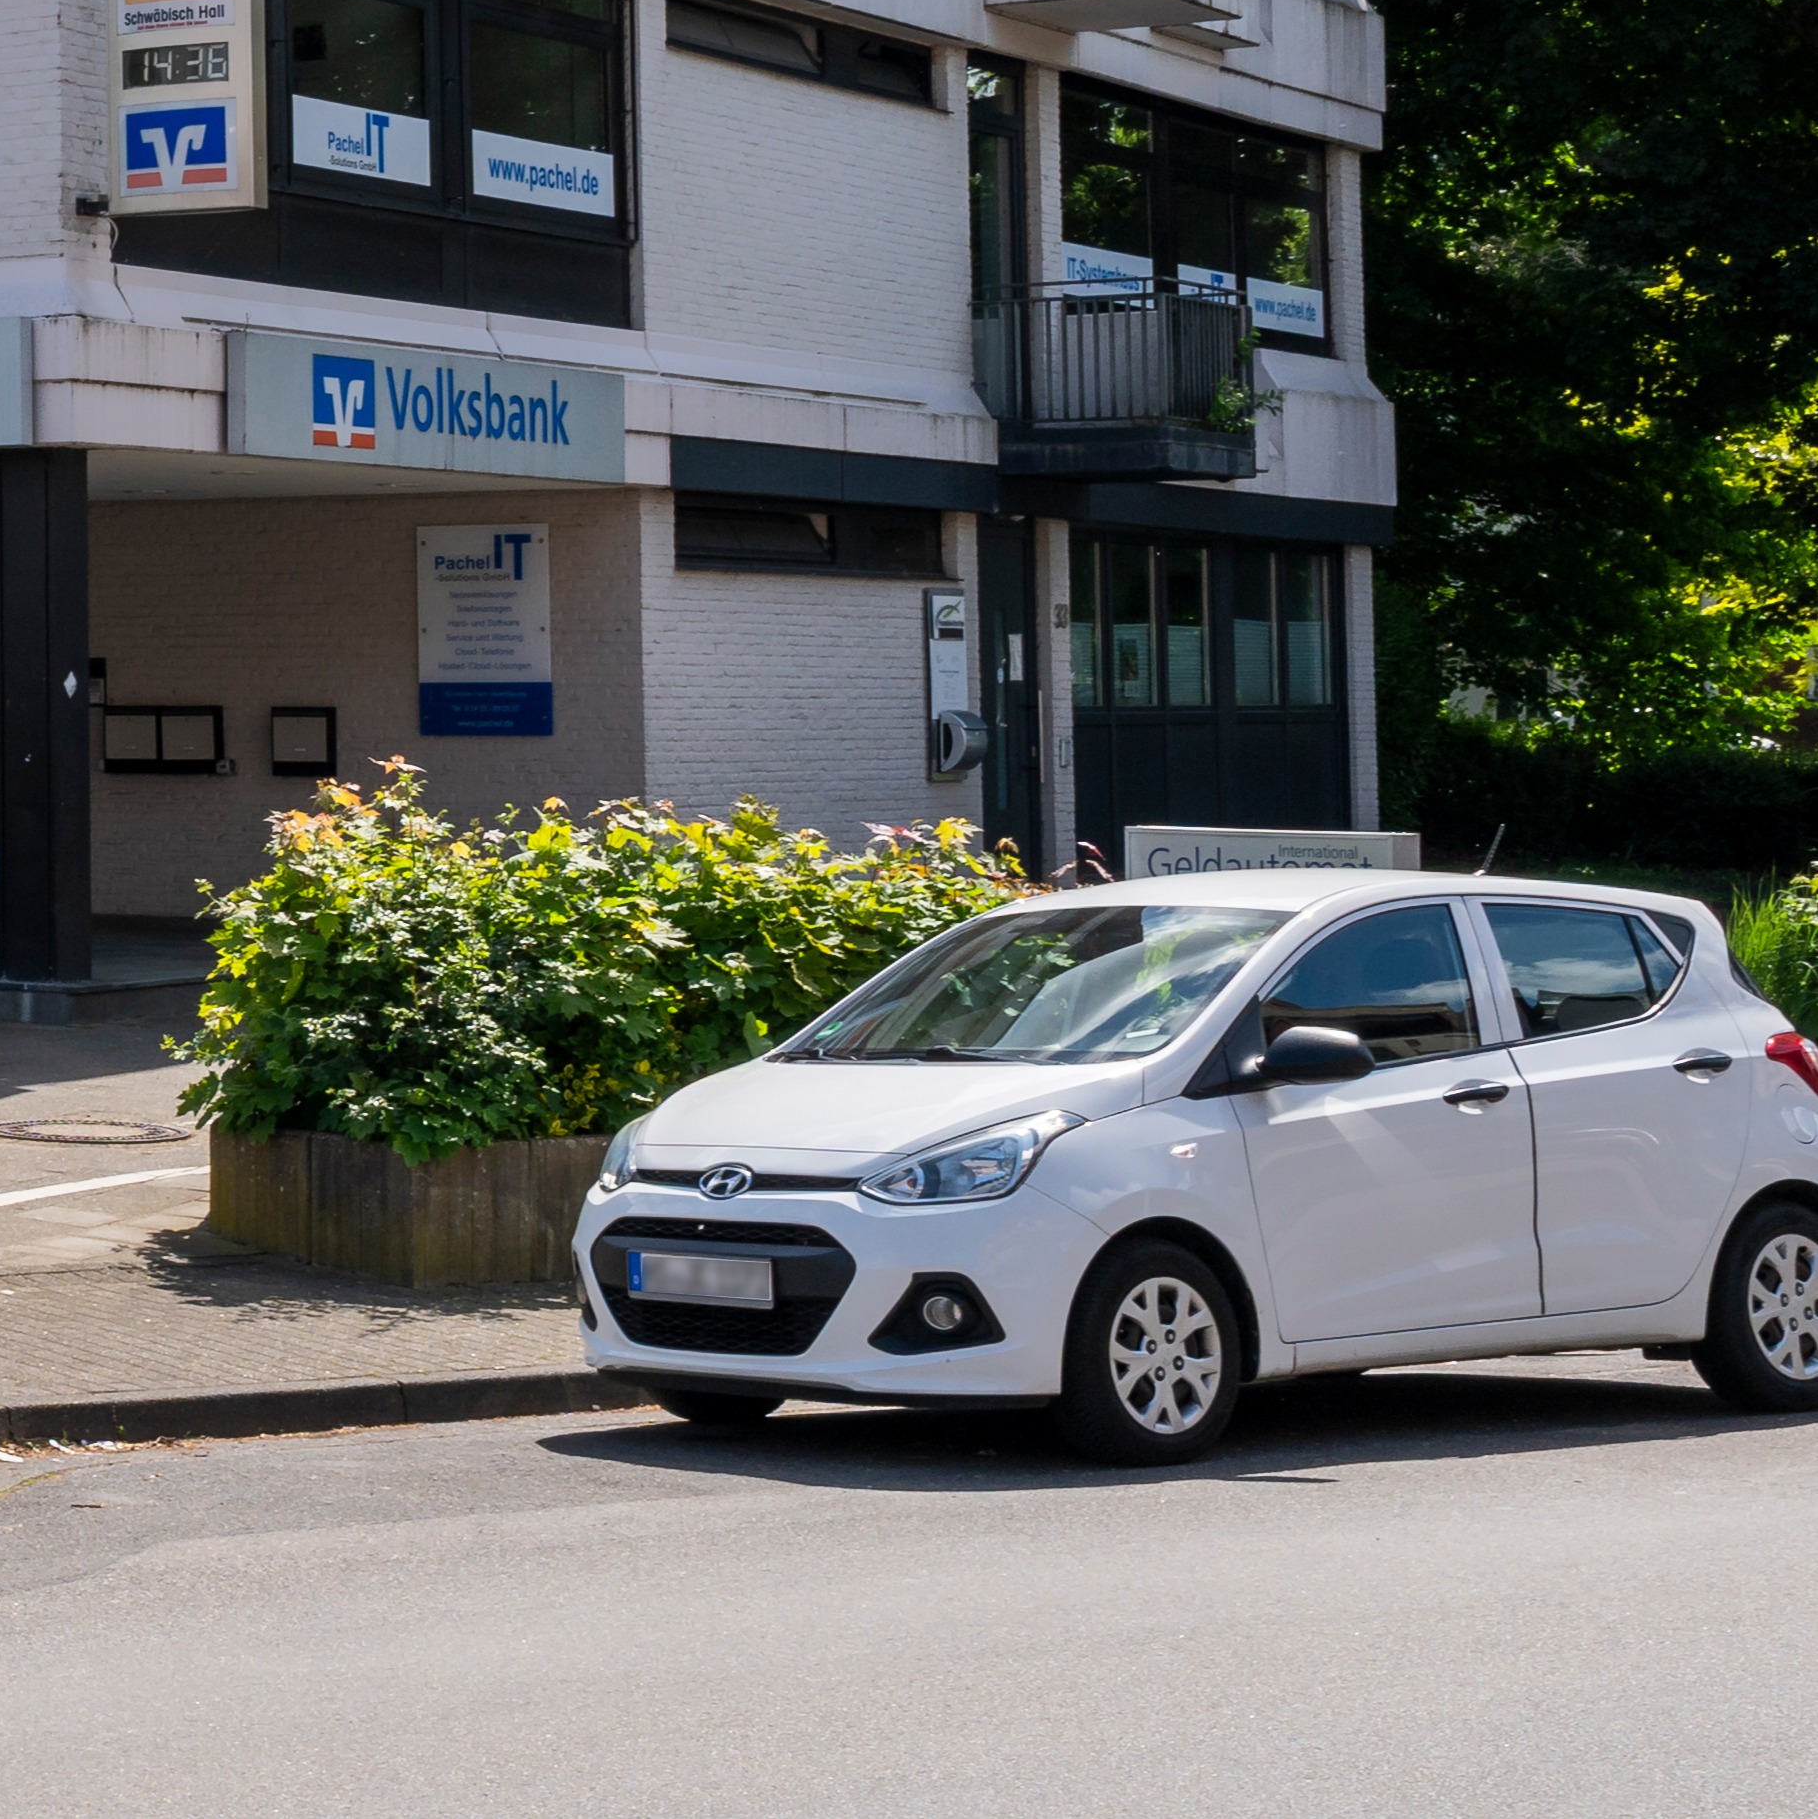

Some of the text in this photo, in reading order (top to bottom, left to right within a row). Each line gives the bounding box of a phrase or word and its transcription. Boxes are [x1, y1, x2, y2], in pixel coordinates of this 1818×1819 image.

[124, 4, 225, 26] Schwäbisch Hall
[144, 44, 226, 82] 14:36
[328, 112, 389, 173] Pachel IT
[359, 159, 377, 172] GmbH
[488, 157, 599, 196] www.pachel.de
[1254, 297, 1316, 322] www.pachel.de
[385, 366, 570, 445] Volksbank
[434, 534, 531, 580] Pachel IT
[483, 573, 510, 581] GmbH
[1147, 847, 1372, 877] Geldaut
[1278, 844, 1358, 859] International
